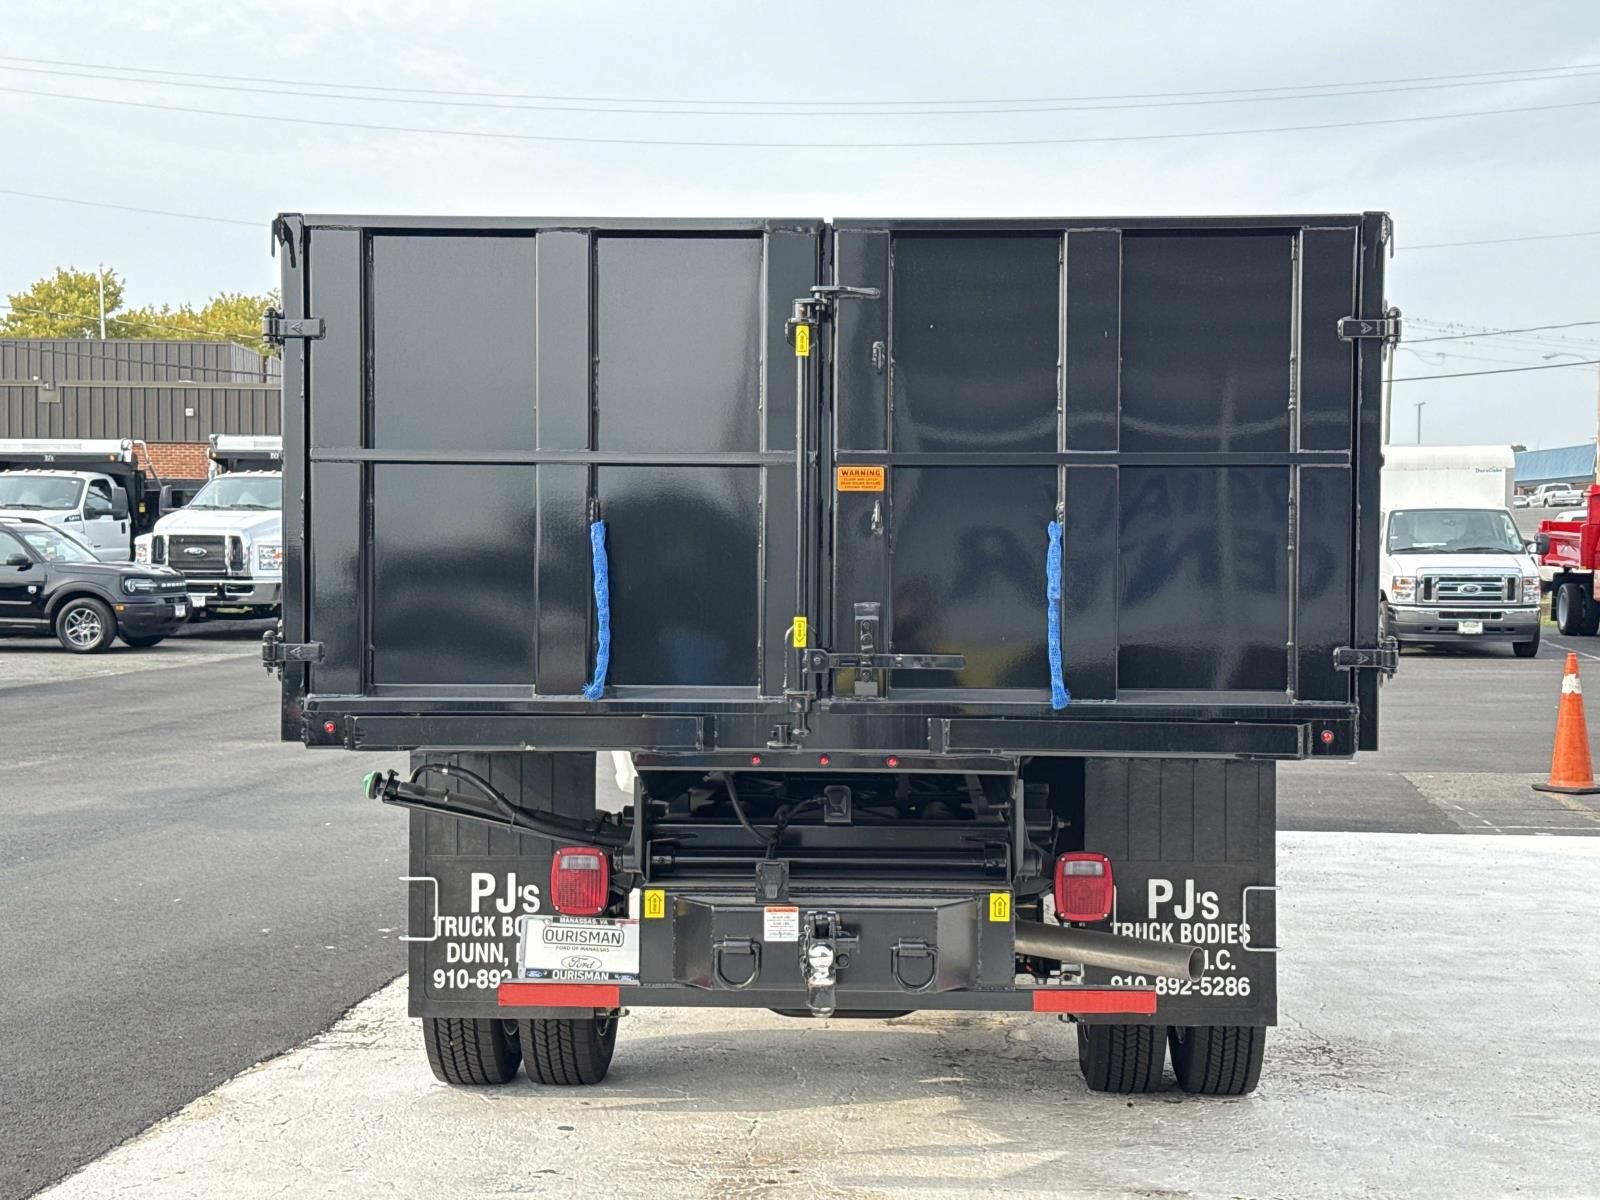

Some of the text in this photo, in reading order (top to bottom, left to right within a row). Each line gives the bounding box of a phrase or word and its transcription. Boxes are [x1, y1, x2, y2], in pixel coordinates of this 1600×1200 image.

[433, 915, 497, 937] TRUCK
[545, 929, 621, 944] OURISMAN
[1110, 922, 1251, 944] TRUCK BODIES
[446, 942, 509, 967] DUNN,
[568, 957, 594, 969] Ford
[552, 969, 609, 981] OURISMAN
[1110, 975, 1250, 996] 910892-5286
